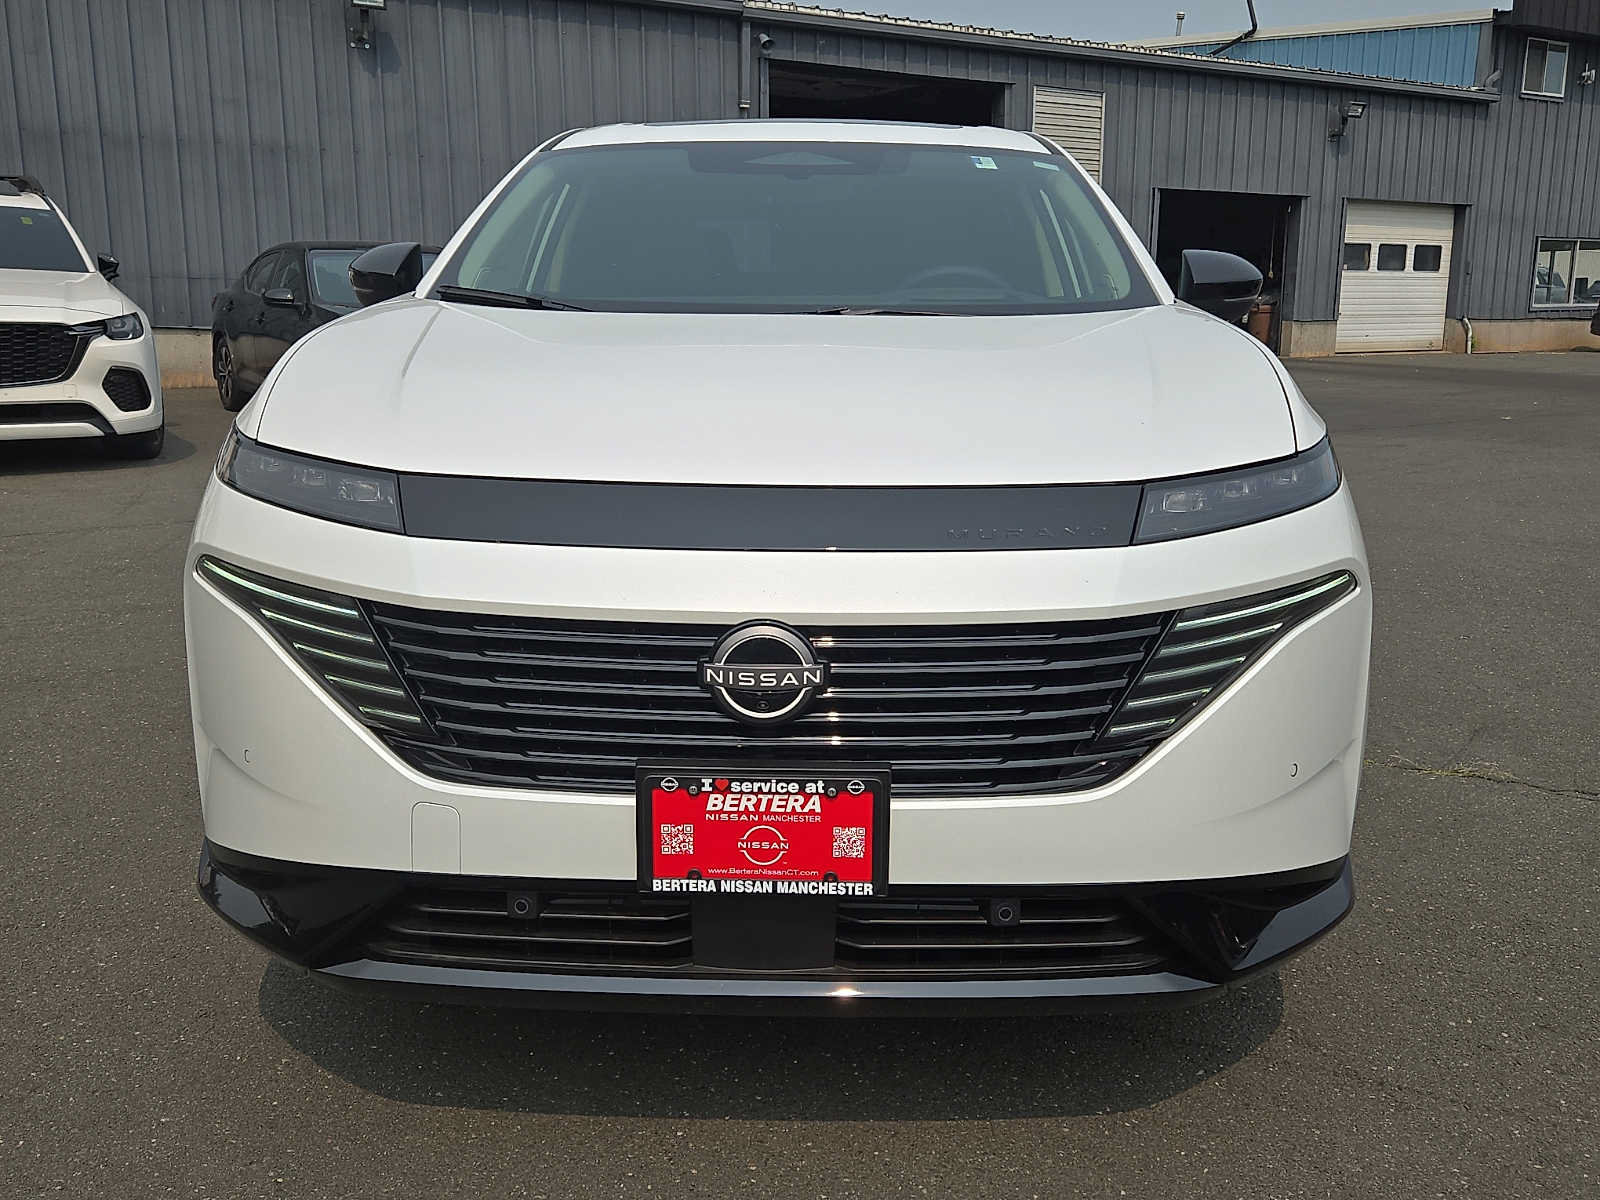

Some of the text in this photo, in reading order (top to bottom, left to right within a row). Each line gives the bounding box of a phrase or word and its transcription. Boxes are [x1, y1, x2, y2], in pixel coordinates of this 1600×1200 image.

[706, 668, 821, 687] NISSAN
[701, 778, 825, 794] I service at
[706, 793, 822, 813] BERTERA
[705, 813, 822, 823] NISSAN MANCHESTER
[737, 841, 789, 850] NISSAN
[707, 868, 819, 877] www.BerteraNissanCT.com
[652, 879, 874, 896] BERTERA NISSAN MANCHESTER
